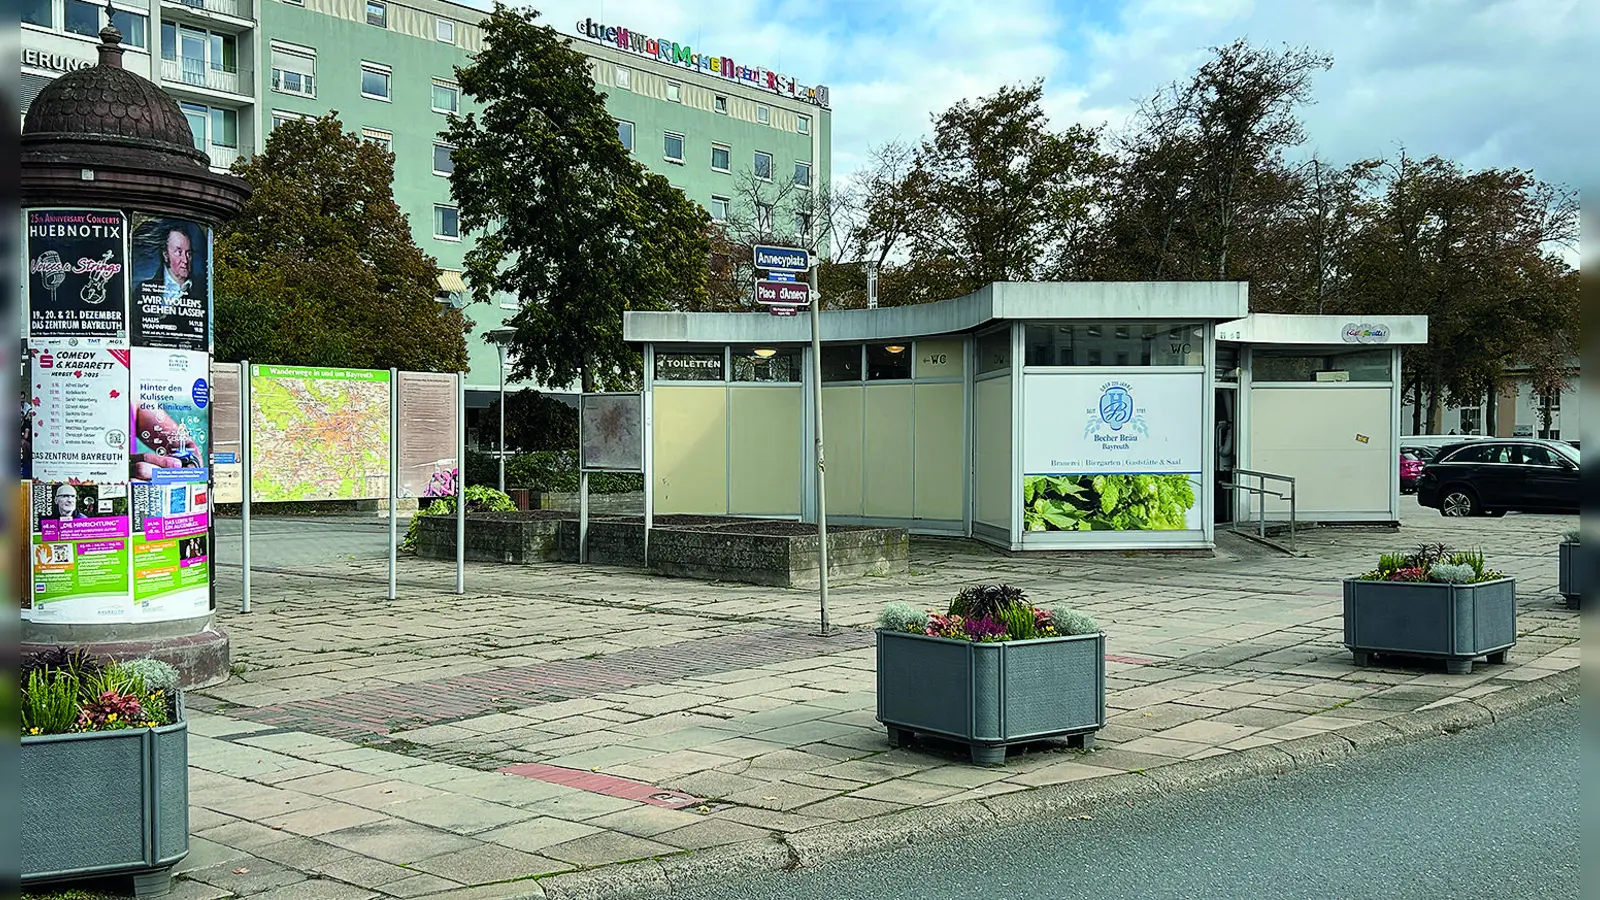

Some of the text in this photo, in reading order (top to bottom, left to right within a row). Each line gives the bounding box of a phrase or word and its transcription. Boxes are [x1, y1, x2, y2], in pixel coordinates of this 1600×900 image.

[30, 224, 120, 238] HUEBNOTIX
[758, 252, 805, 267] Annecyplatz
[72, 257, 121, 278] Strings
[758, 286, 776, 299] Place
[80, 310, 121, 320] DEZEMBER
[142, 305, 176, 315] GEHEN
[46, 321, 80, 330] ZENTRUM
[81, 321, 122, 330] BAYREUTH
[1171, 344, 1191, 354] WC
[666, 360, 720, 368] TOILETTEN
[931, 354, 946, 364] WC
[65, 361, 114, 369] KABARETT
[270, 368, 312, 377] Wanderwege
